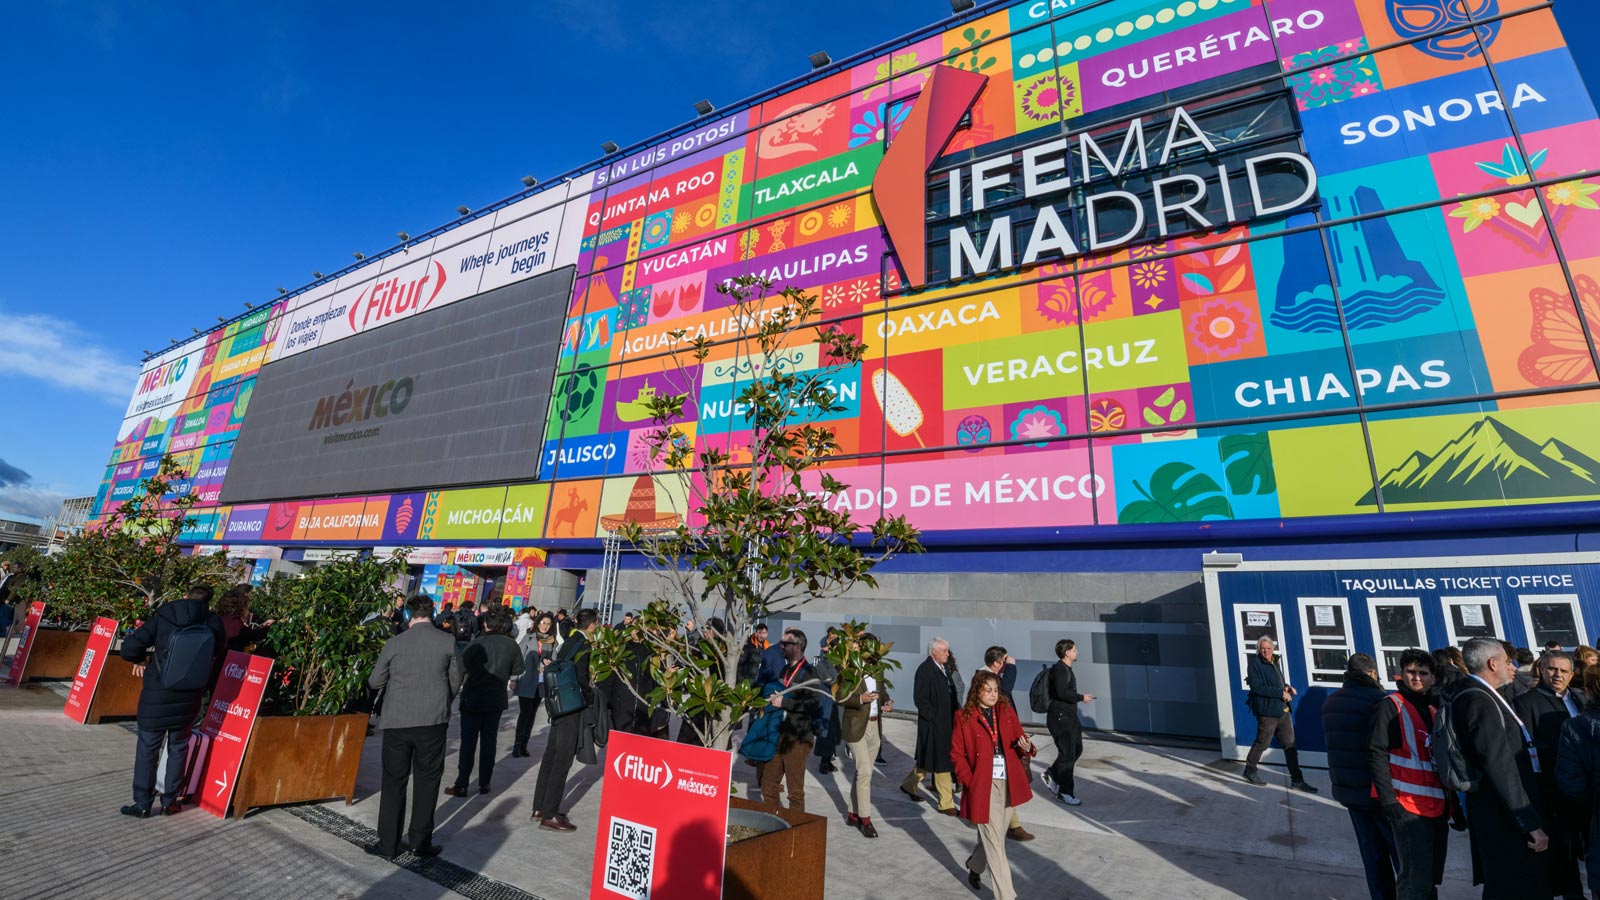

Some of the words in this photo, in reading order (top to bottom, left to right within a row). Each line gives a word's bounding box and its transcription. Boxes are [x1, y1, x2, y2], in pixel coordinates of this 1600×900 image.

[1101, 9, 1324, 88] QUERÉTARO
[1340, 82, 1547, 145] SONORA
[597, 164, 627, 185] SAN
[631, 147, 666, 172] LUIS
[671, 117, 736, 156] POTOSÍ
[949, 106, 1217, 218] IFEMA
[589, 184, 671, 226] QUINTANA
[676, 171, 715, 194] ROO
[754, 161, 859, 205] TLAXCALA
[949, 151, 1318, 282] MADRID
[459, 250, 494, 274] Where
[495, 231, 549, 265] journeys
[511, 249, 546, 275] begin
[642, 239, 727, 276] YUCATÁN
[241, 312, 267, 329] HIDALGO
[290, 318, 314, 335] Donde
[312, 305, 347, 327] empiezan
[619, 304, 798, 356] AGUASCALIENTES
[876, 301, 1000, 339] OAXACA
[285, 336, 296, 350] los
[298, 329, 318, 347] viajes
[963, 339, 1159, 386] VERACRUZ
[1234, 360, 1451, 408] CHIAPAS
[184, 417, 205, 428] SINALOA
[324, 427, 381, 445] visitmexico.com
[142, 461, 159, 471] PUEBLA
[547, 443, 616, 466] JALISCO
[113, 485, 135, 496] ZACATECAS
[785, 486, 898, 512] TADO
[910, 483, 951, 508] DE
[964, 473, 1106, 505] MÉXICO
[228, 520, 262, 532] DURANGO
[299, 516, 321, 529] BAJA
[323, 514, 379, 528] CALIFORNIA
[448, 504, 534, 525] MICHOACÁN
[1342, 578, 1436, 592] TAQUILLAS
[1440, 576, 1501, 590] TICKET
[1506, 574, 1574, 588] OFFICE
[213, 700, 243, 716] PABELLÓN
[243, 708, 251, 719] 12
